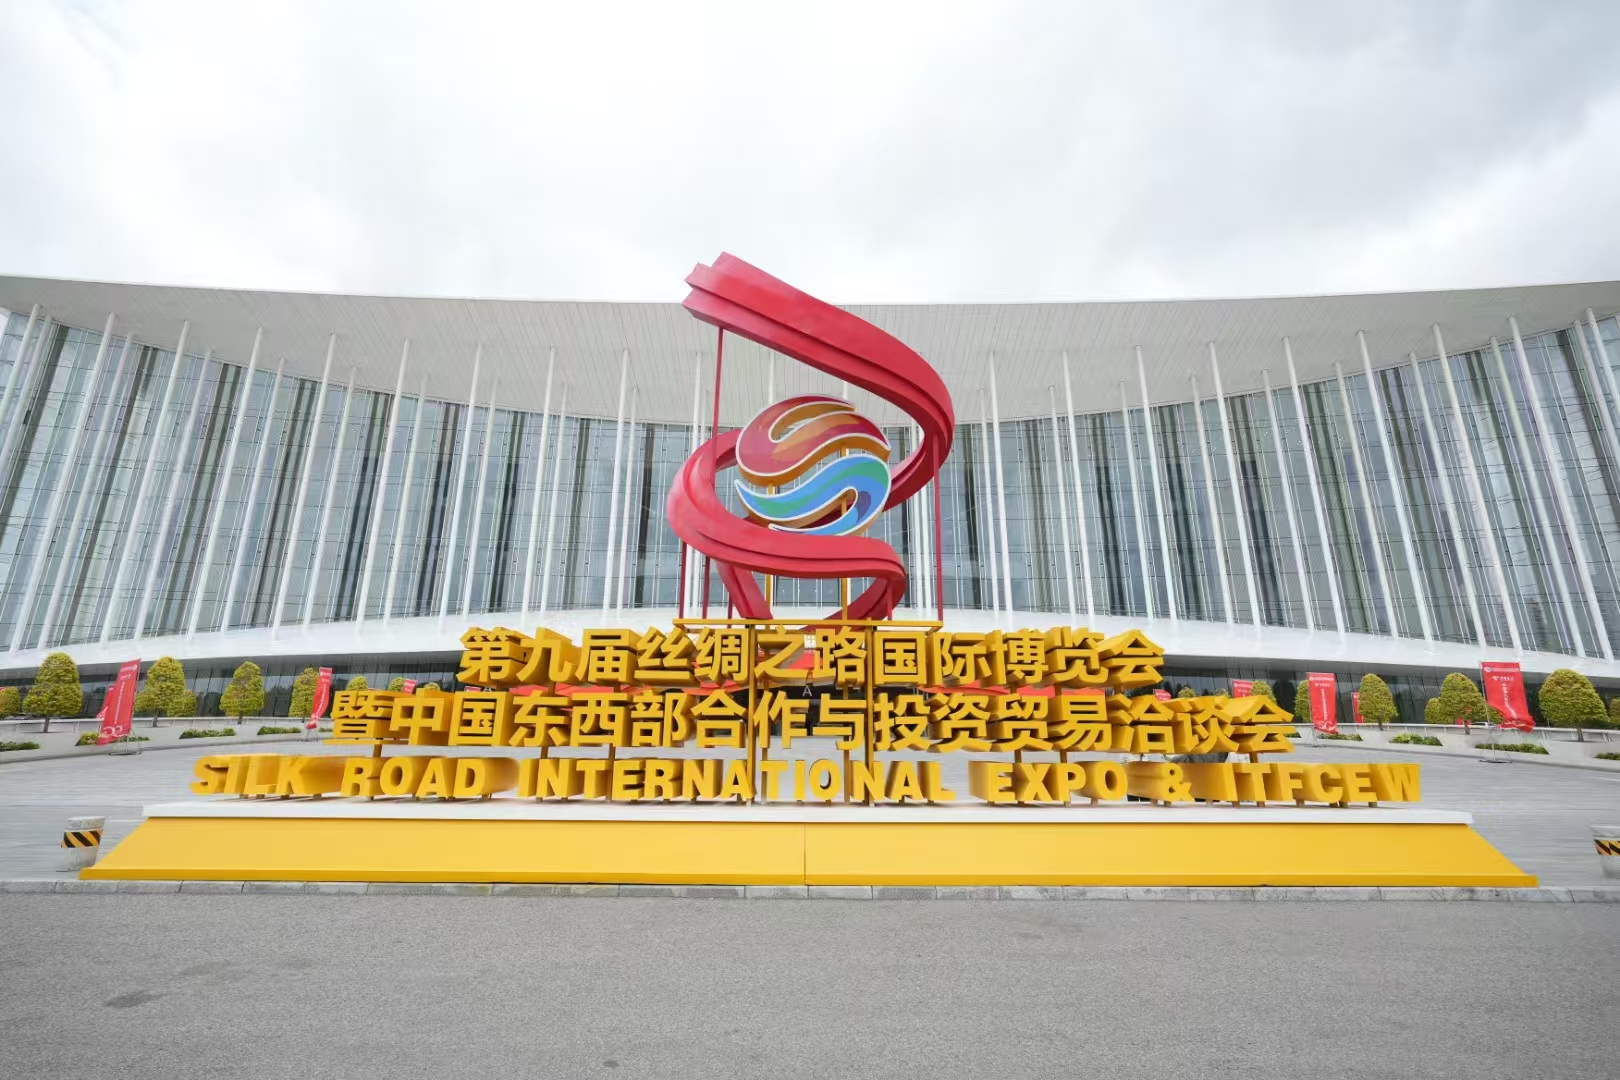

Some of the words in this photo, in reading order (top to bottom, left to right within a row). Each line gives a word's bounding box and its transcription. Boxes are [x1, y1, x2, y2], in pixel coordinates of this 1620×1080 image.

[456, 626, 1164, 685] 第九届丝绸之路国际博览会
[802, 685, 812, 696] A
[326, 688, 1294, 753] 暨中国东西部合作与投资贸易洽谈会
[190, 754, 309, 796] SILK
[340, 756, 492, 798] ROAD
[517, 758, 955, 802] INTERNATIONAL
[986, 760, 1128, 803] EXPO
[1157, 762, 1195, 802] &
[1221, 763, 1421, 803] ITFCEW
